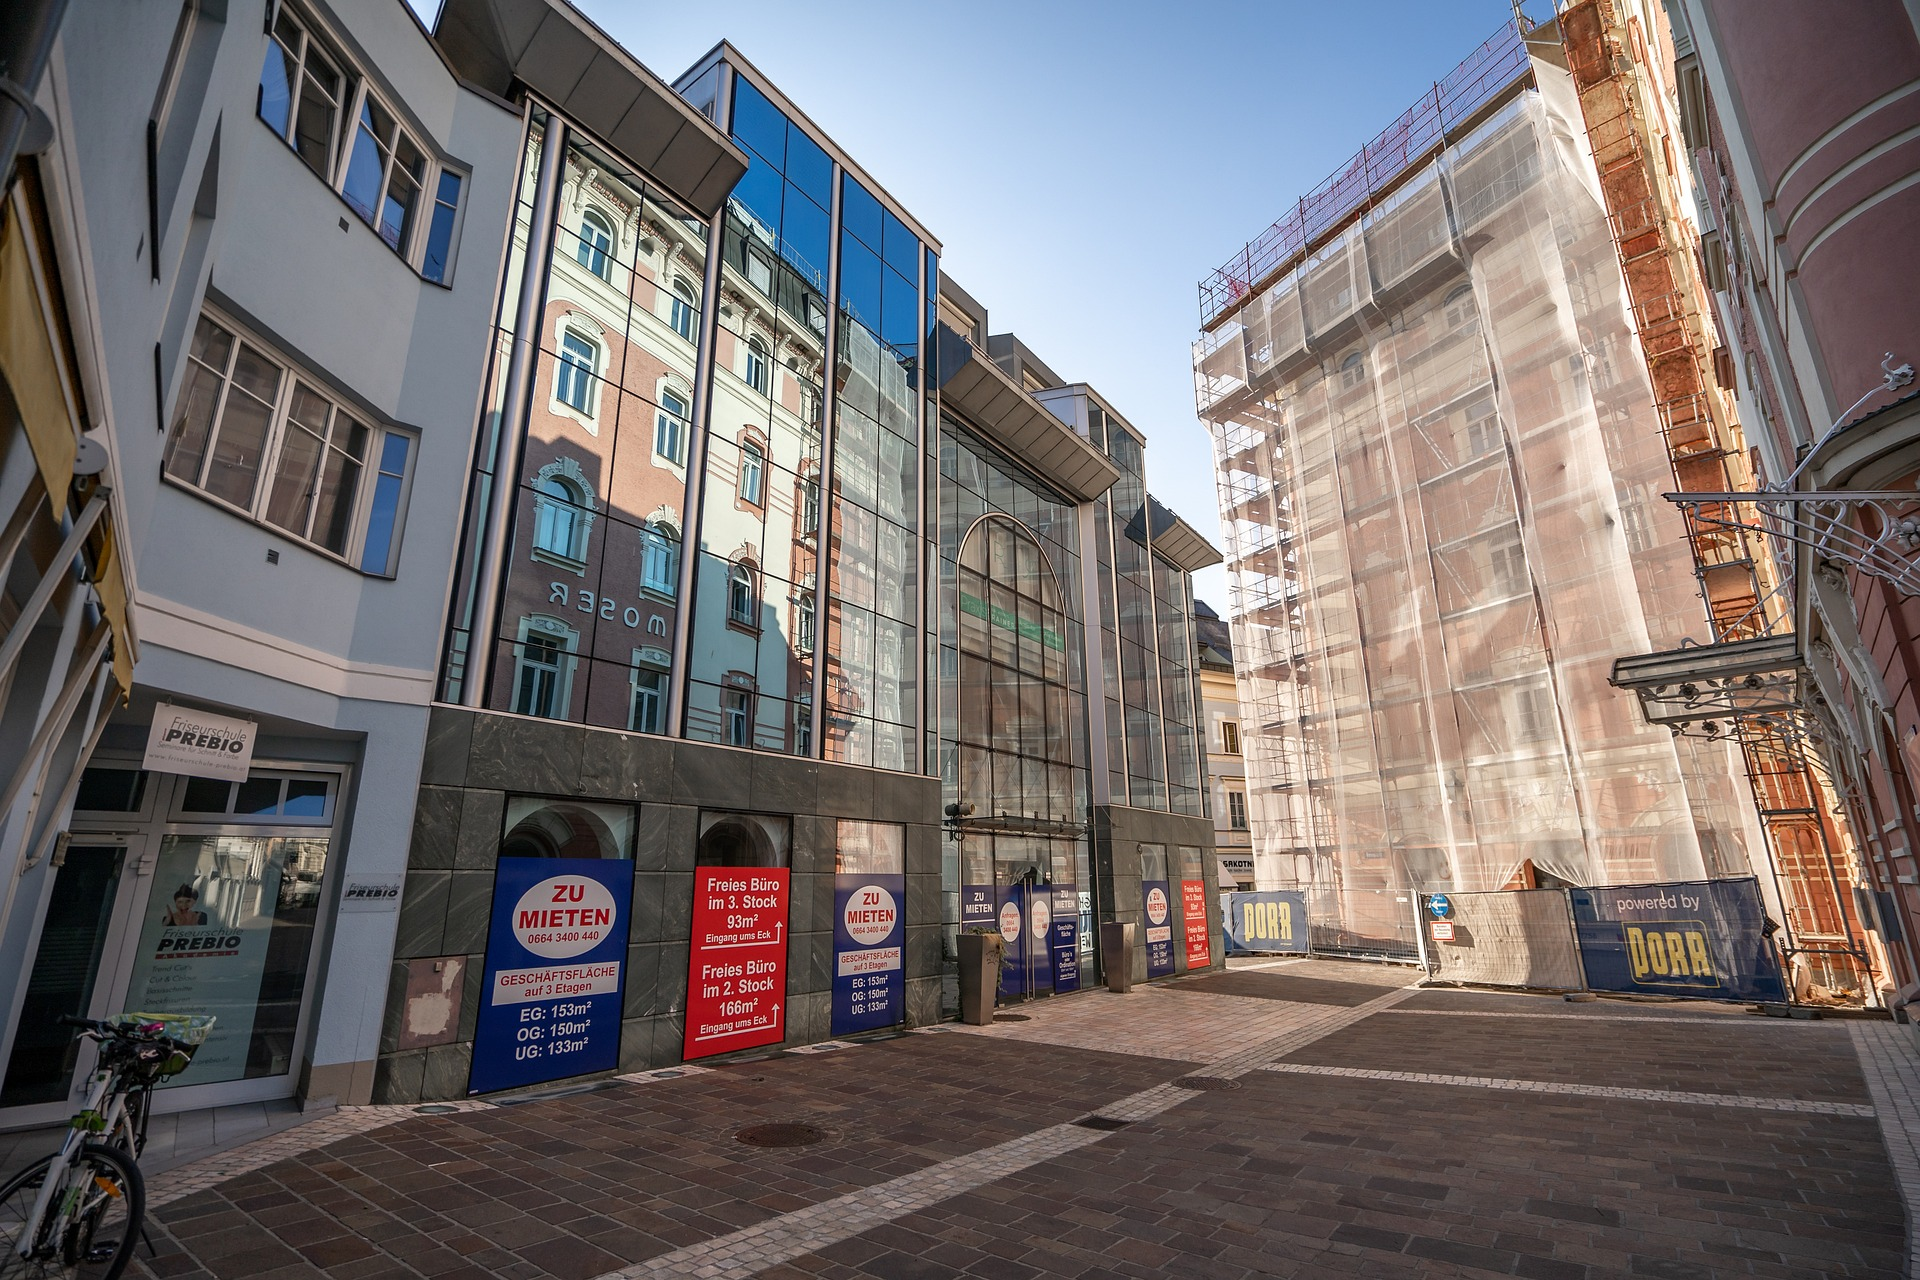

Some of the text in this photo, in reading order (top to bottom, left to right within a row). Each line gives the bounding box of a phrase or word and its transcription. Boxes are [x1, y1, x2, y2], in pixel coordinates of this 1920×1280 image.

[171, 717, 246, 742] Friseurschule
[166, 729, 243, 753] PREBIO
[157, 741, 186, 752] Seminare
[223, 752, 239, 760] Farbe
[708, 878, 779, 892] Freies Büro
[552, 885, 584, 902] ZU
[863, 893, 879, 905] ZU
[974, 892, 984, 901] ZU
[1061, 890, 1068, 898] ZU
[708, 895, 777, 909] im 3. Stock
[966, 904, 992, 913] MIETEN
[1055, 900, 1075, 908] MIETEN
[1617, 894, 1699, 913] powered by
[519, 908, 610, 929] MIETEN
[727, 914, 758, 929] 93m²
[848, 909, 893, 924] MIETEN
[1244, 902, 1292, 942] PORR
[163, 928, 243, 937] Friseurschule
[528, 931, 598, 944] 0664 3400 440
[706, 931, 771, 944] Eingang ums Eck
[157, 936, 241, 951] PREBIO
[841, 950, 899, 963] GESCHÄFTSFLÄCHE
[1627, 927, 1712, 978] PORR
[702, 960, 776, 979] Freies Büro
[854, 963, 863, 971] auf
[869, 962, 887, 970] Etagen
[500, 967, 615, 986] GESCHÄFTSFLÄCHE
[852, 978, 865, 988] EG:
[525, 983, 591, 997] auf 3 Etagen
[703, 976, 774, 998] im 2. Stock
[852, 988, 888, 1001] OG: 150m²
[520, 1001, 592, 1022] EG: 153m²
[720, 998, 758, 1017] 166m²
[852, 1004, 865, 1014] UG:
[517, 1020, 590, 1041] OG: 150m²
[700, 1015, 767, 1034] Eingang ums Eck
[515, 1037, 588, 1060] UG: 133m²
